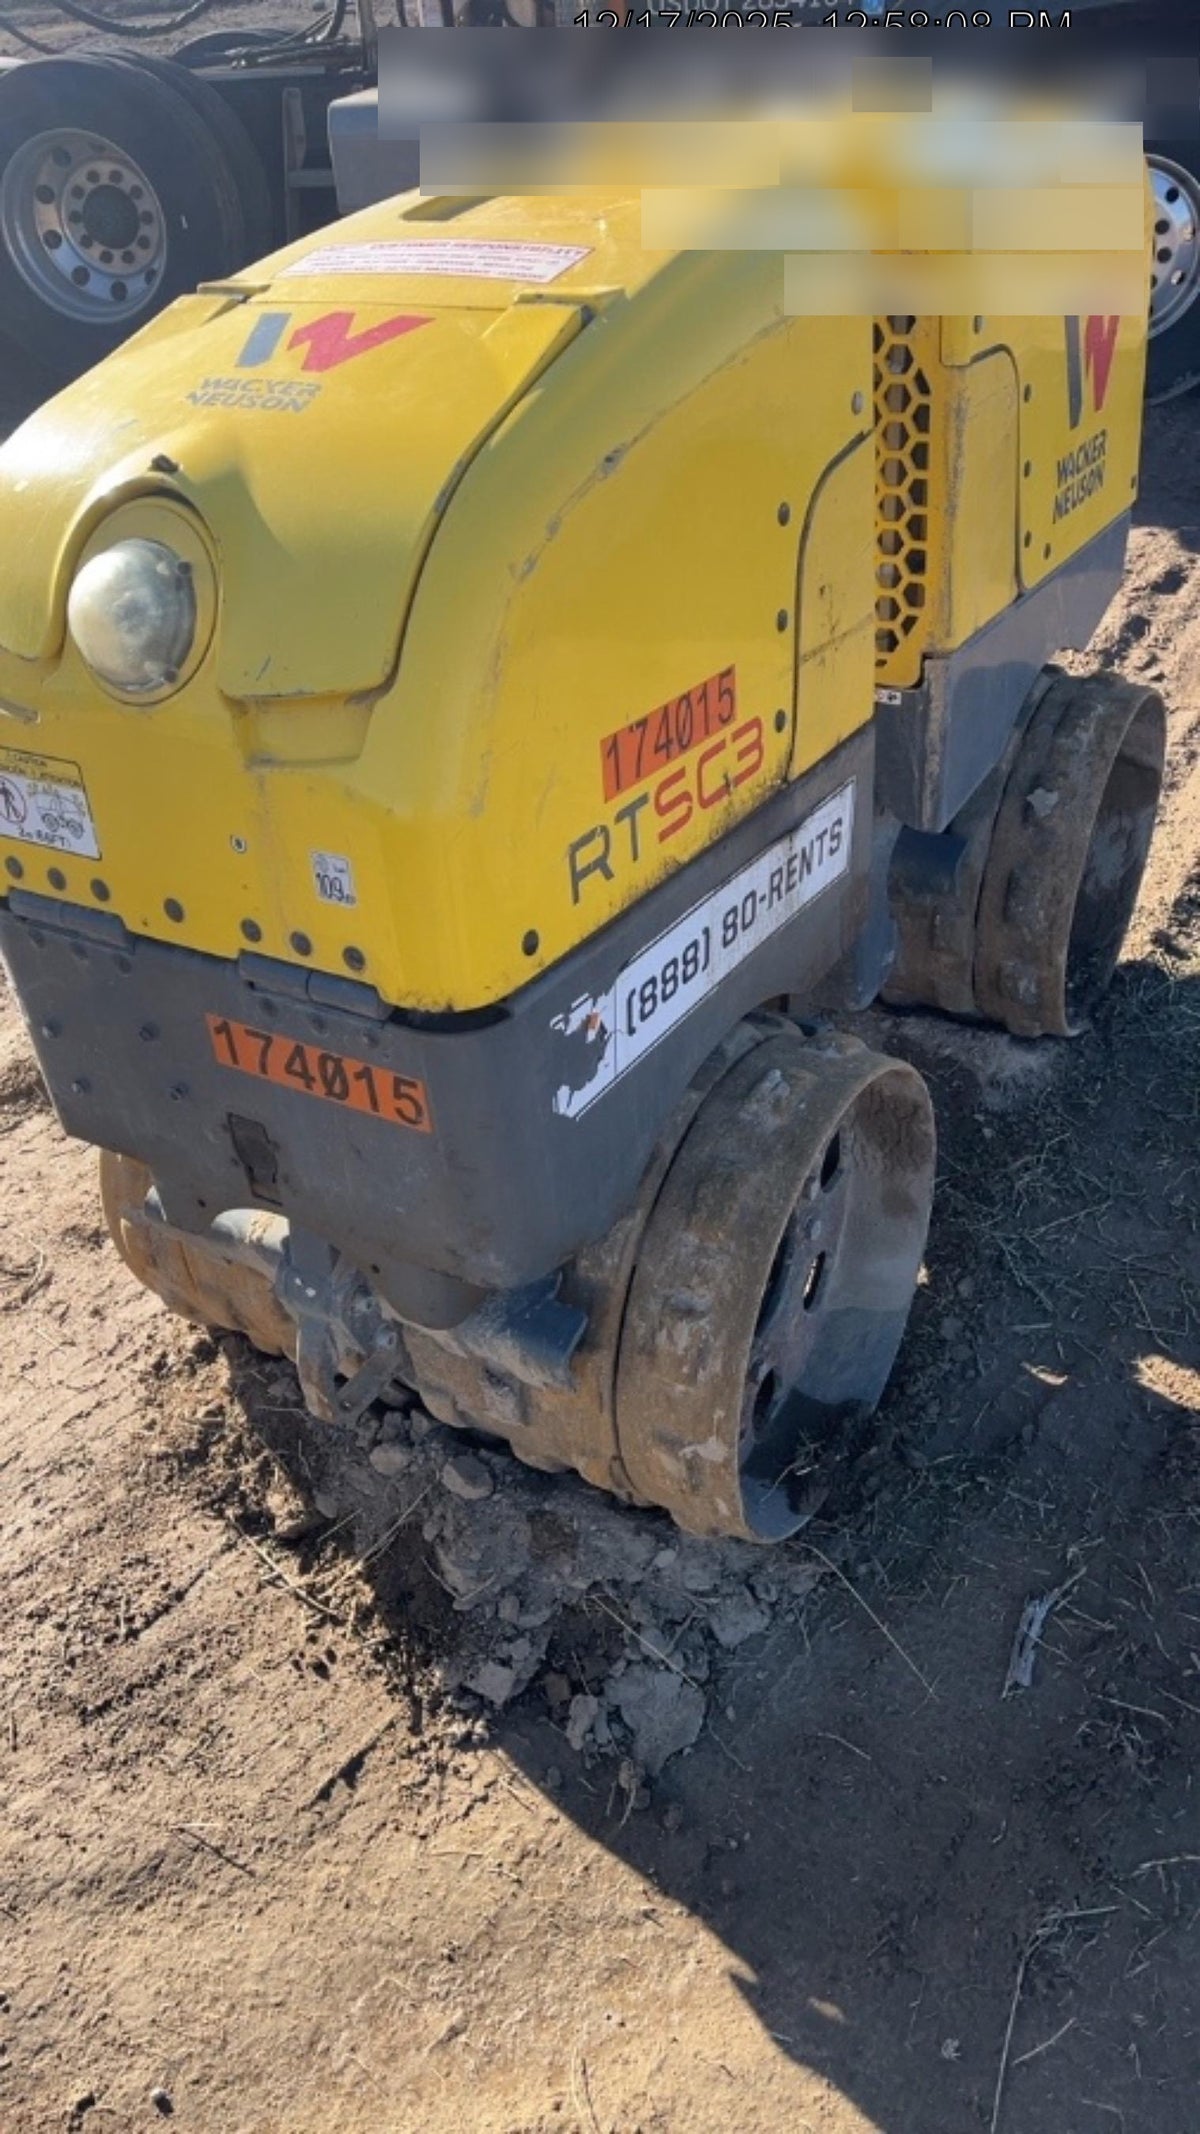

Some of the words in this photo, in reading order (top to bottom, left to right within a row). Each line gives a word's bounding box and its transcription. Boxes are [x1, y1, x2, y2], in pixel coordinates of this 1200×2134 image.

[186, 391, 312, 413] NEUSON
[1053, 459, 1106, 525] NEUSON
[1057, 429, 1107, 489] WACKER
[607, 668, 735, 792] 174015
[567, 715, 764, 905] RTSC3
[626, 927, 710, 1036] (888)
[722, 817, 843, 949] 80-RENTS
[213, 1019, 424, 1126] 174015
